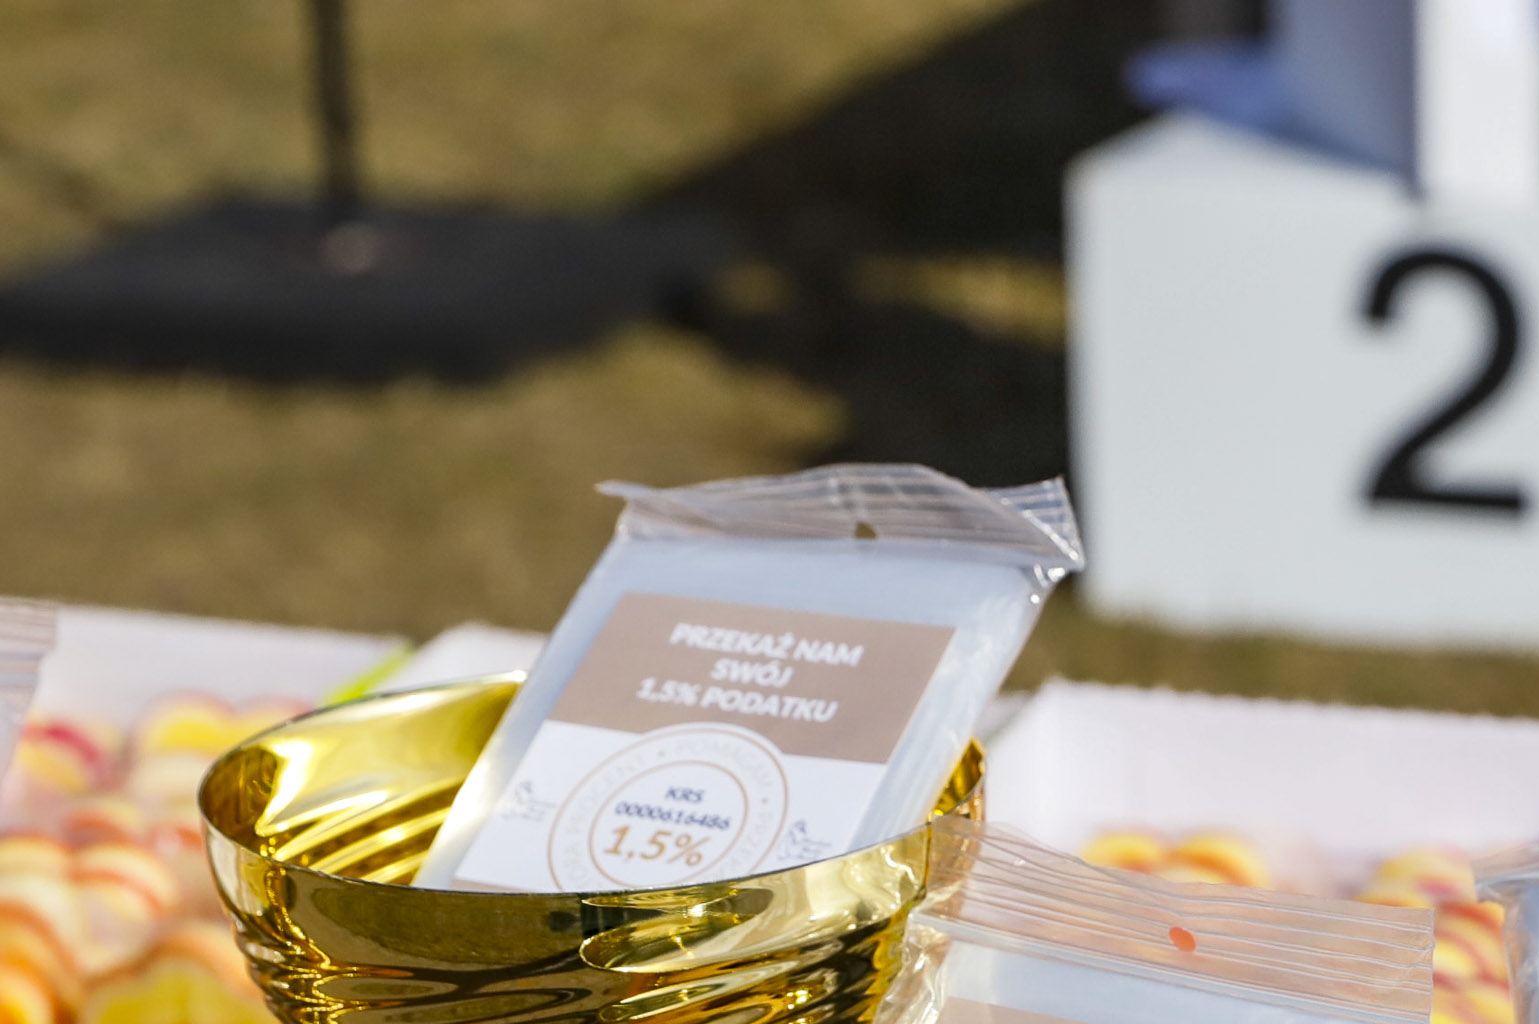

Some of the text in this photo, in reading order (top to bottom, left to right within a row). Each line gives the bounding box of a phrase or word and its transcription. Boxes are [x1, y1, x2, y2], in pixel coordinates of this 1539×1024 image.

[1356, 244, 1531, 520] 2
[669, 622, 865, 667] PRZEKAŻ NAM
[710, 657, 794, 689] SWÓJ
[636, 676, 839, 723] 1,5% PODATKU
[664, 785, 708, 803] KRS
[603, 825, 711, 867] 1,5%
